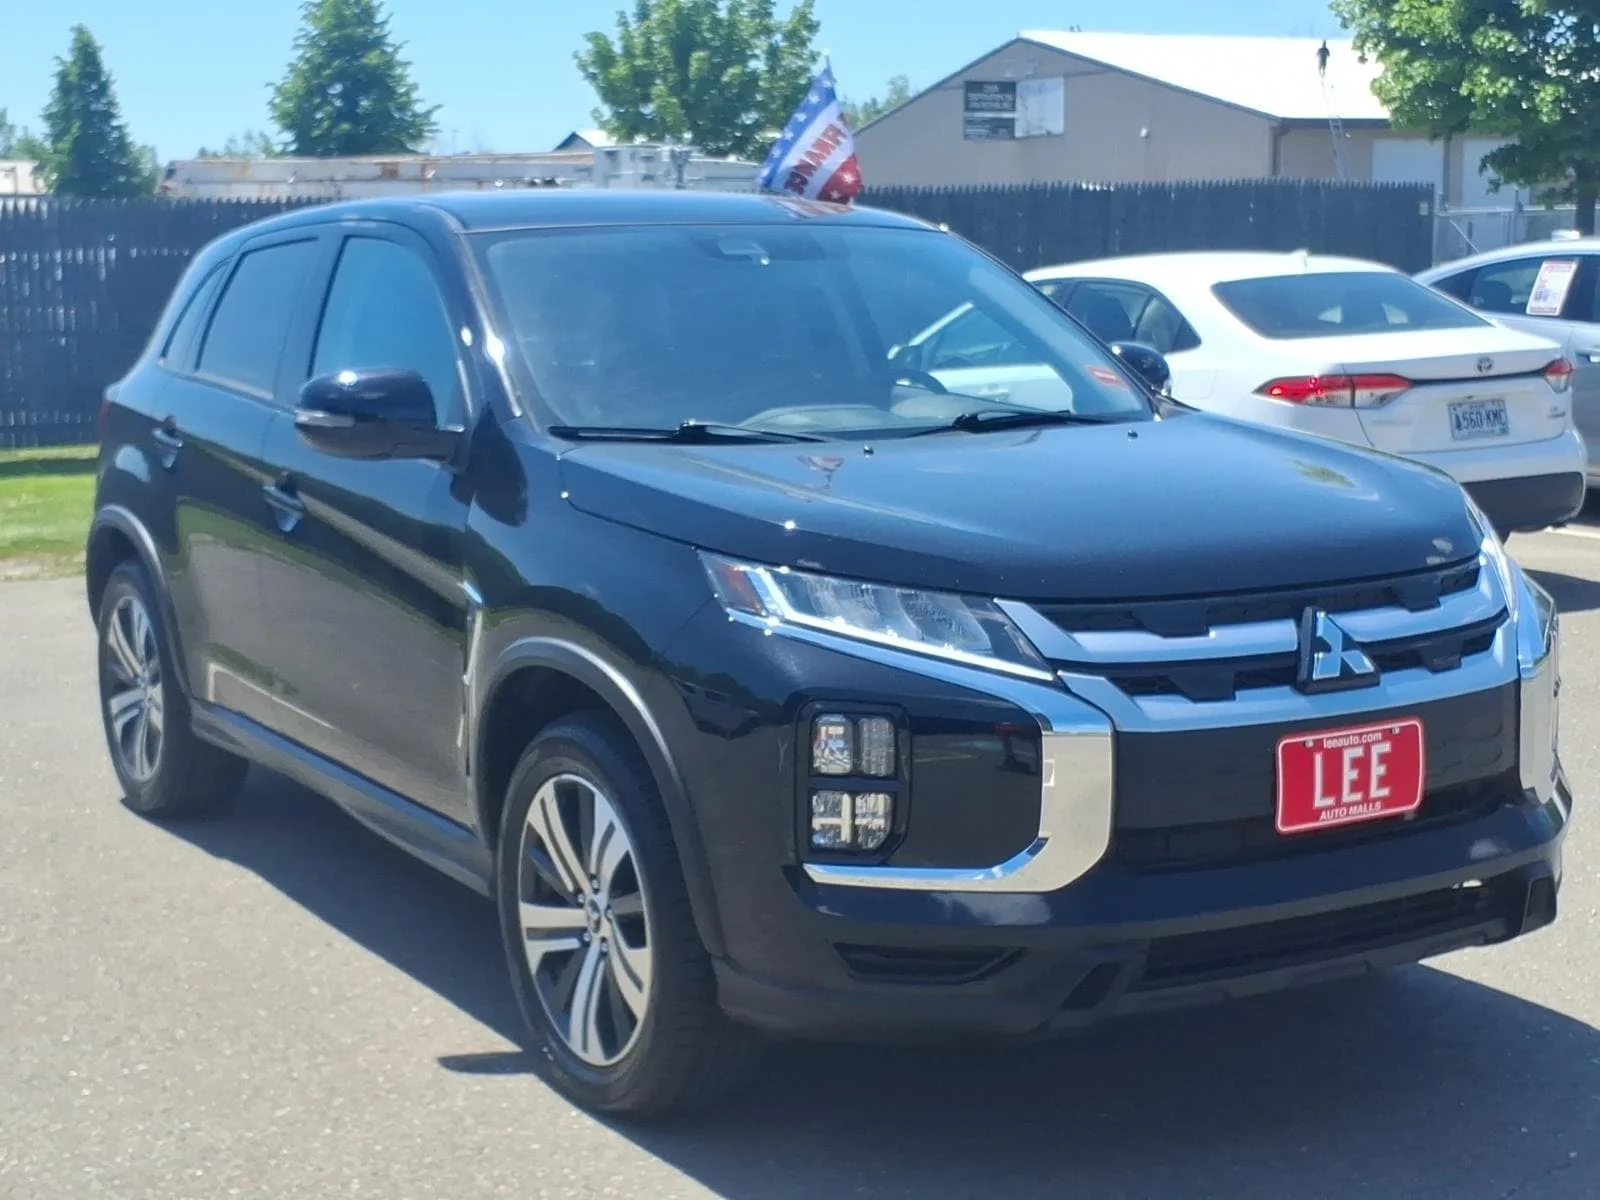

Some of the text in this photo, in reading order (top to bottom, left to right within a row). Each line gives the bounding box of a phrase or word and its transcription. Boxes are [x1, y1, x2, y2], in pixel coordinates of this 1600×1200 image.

[1323, 732, 1382, 749] leeauto.com
[1313, 741, 1392, 809] LEE
[1319, 801, 1382, 821] AUTO MALLS
